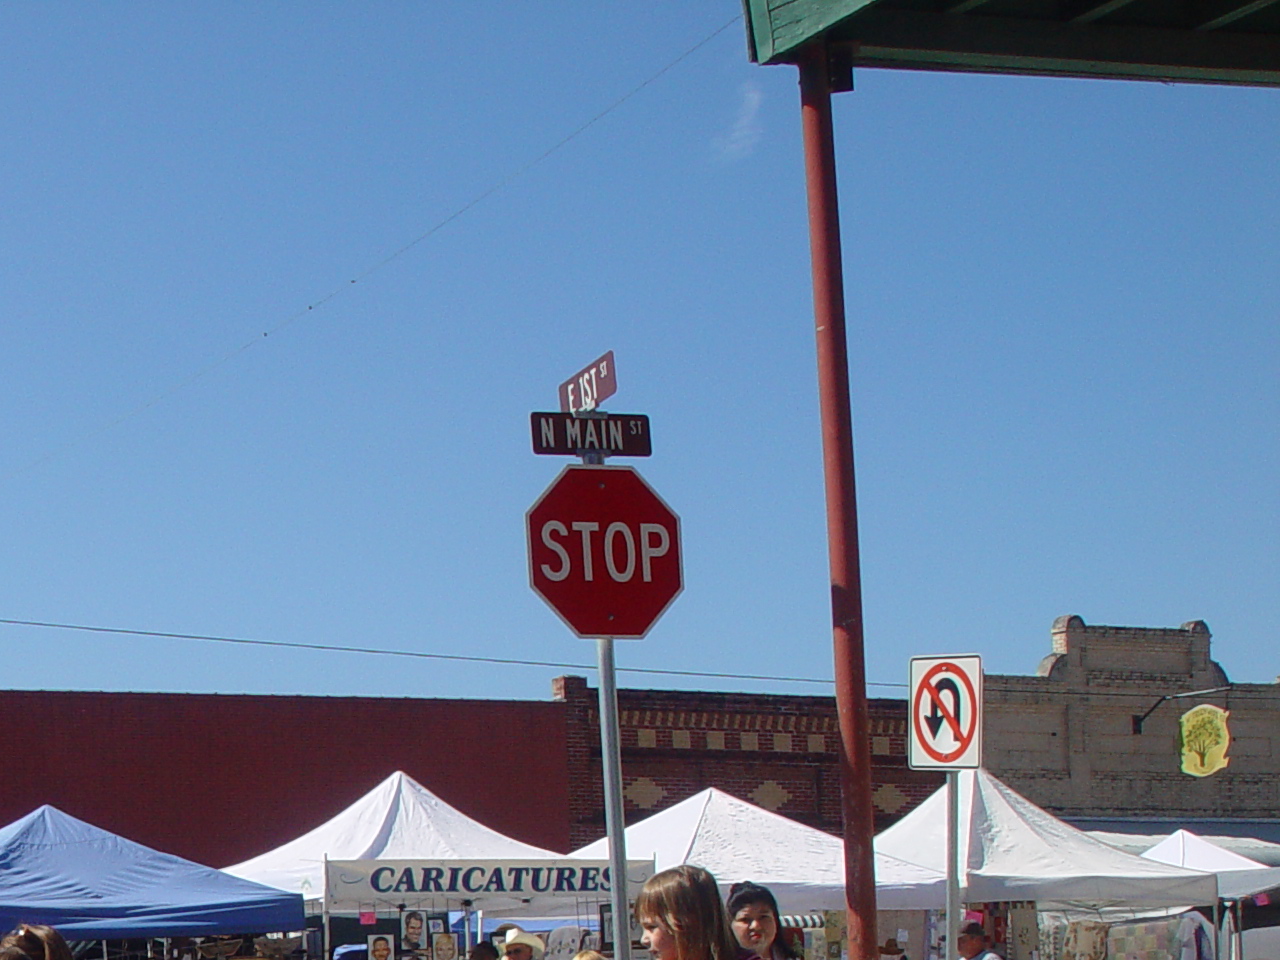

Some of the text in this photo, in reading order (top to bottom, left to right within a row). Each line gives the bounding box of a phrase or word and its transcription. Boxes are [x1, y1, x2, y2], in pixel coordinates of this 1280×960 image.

[568, 383, 576, 414] E
[600, 361, 607, 378] ST
[540, 417, 642, 450] N MAIN ST
[541, 520, 670, 582] STOP
[370, 866, 612, 893] CARICATURES
